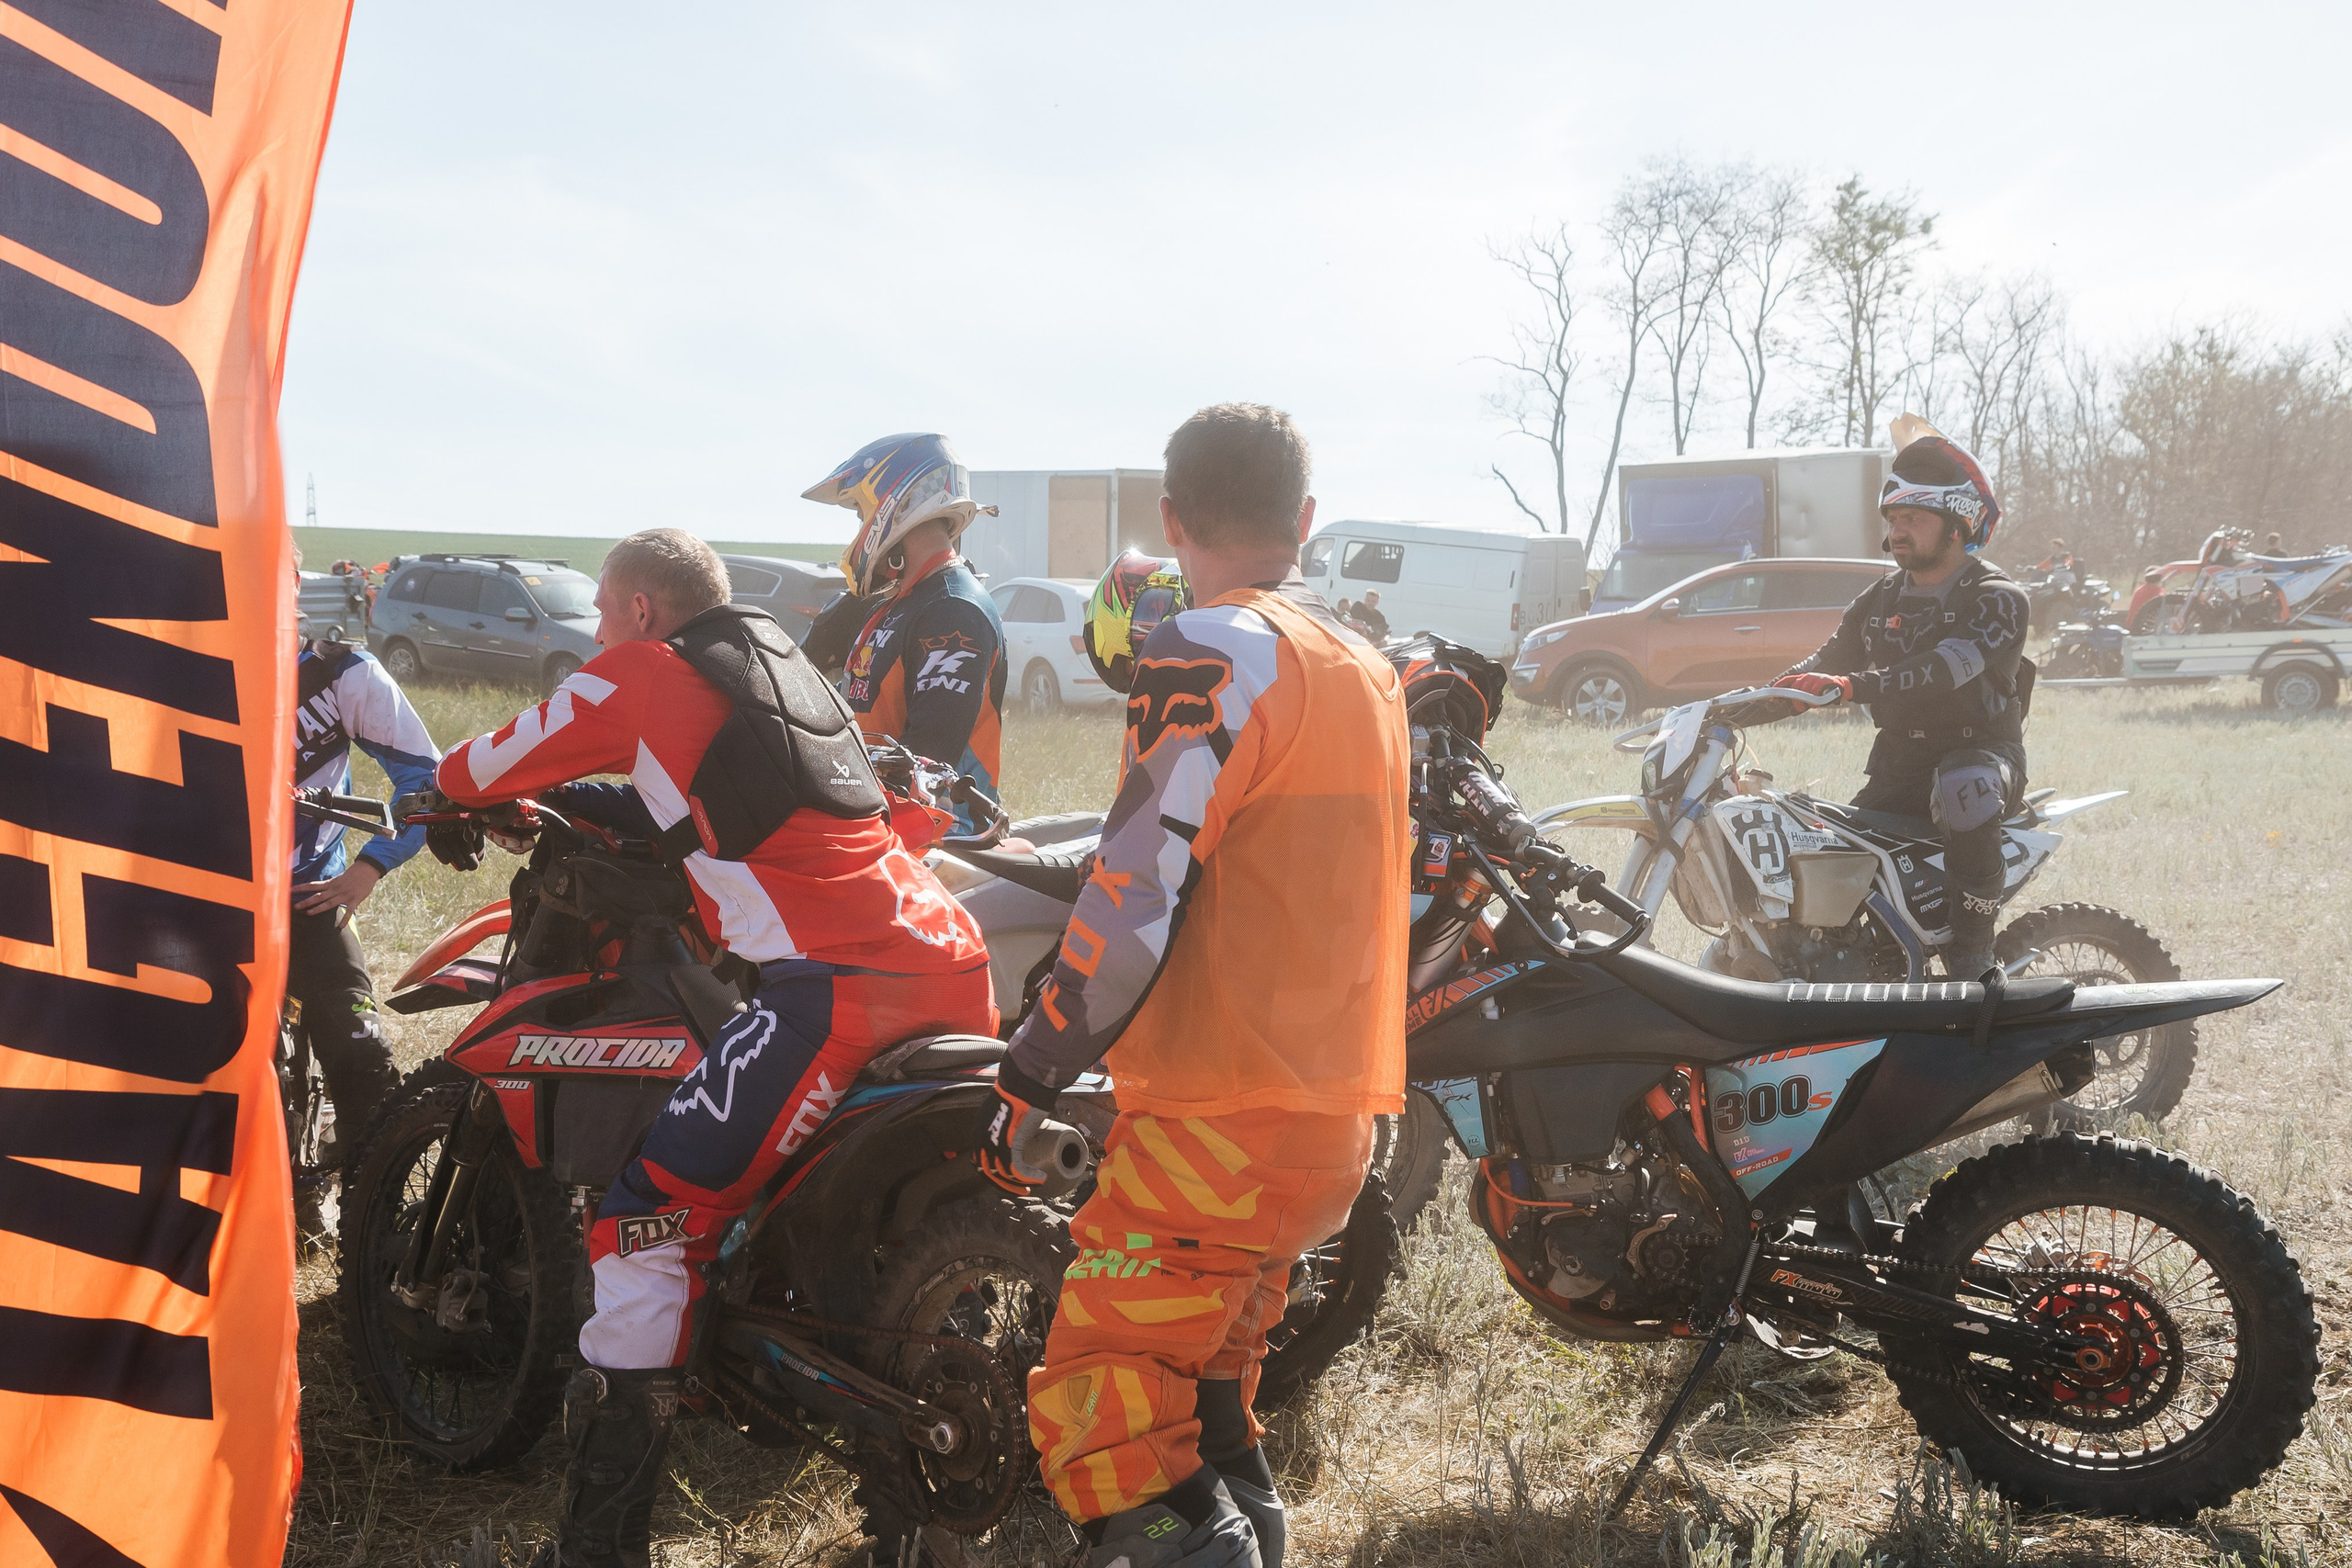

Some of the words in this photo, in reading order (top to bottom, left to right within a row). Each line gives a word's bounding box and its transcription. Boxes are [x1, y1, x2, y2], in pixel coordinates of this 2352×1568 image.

[1880, 664, 1933, 694] FOX
[830, 778, 863, 786] BAUER
[1956, 776, 2000, 813] FO
[697, 807, 712, 840] VAPOR
[1792, 829, 1839, 846] Husqvarna
[1910, 886, 1943, 902] Husqvarna
[1042, 855, 1132, 1033] FOX
[507, 1034, 687, 1068] PROCIDA
[493, 1079, 532, 1090] 300
[775, 1070, 850, 1156] FOX
[1736, 1156, 1779, 1177] OFF-ROAD
[617, 1206, 696, 1258] FOX
[780, 1352, 820, 1382] PROCIDA
[1084, 1388, 1100, 1418] LEATT
